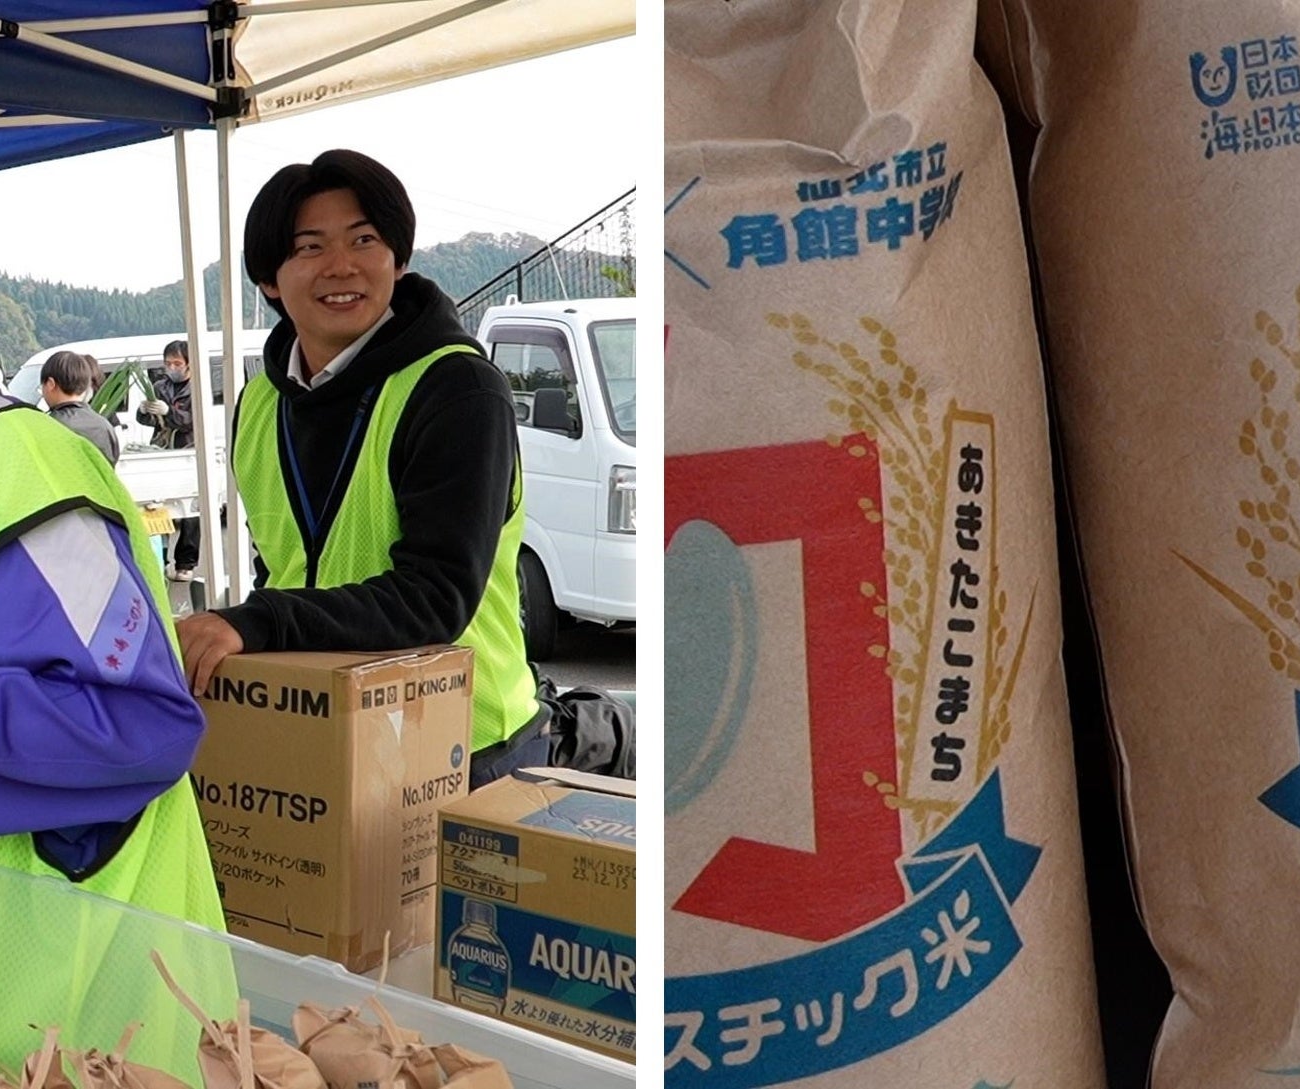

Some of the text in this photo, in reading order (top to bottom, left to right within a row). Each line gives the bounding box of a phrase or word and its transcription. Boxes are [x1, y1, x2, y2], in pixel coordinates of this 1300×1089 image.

[1240, 35, 1300, 70] 日本
[930, 443, 984, 783] あきたこまち
[418, 672, 467, 698] KING JIM
[274, 686, 330, 719] JIM
[402, 771, 463, 809] No.187TSP
[459, 831, 501, 851] 041199
[452, 874, 507, 898] ペットボトル
[451, 941, 508, 971] AQUARIUS
